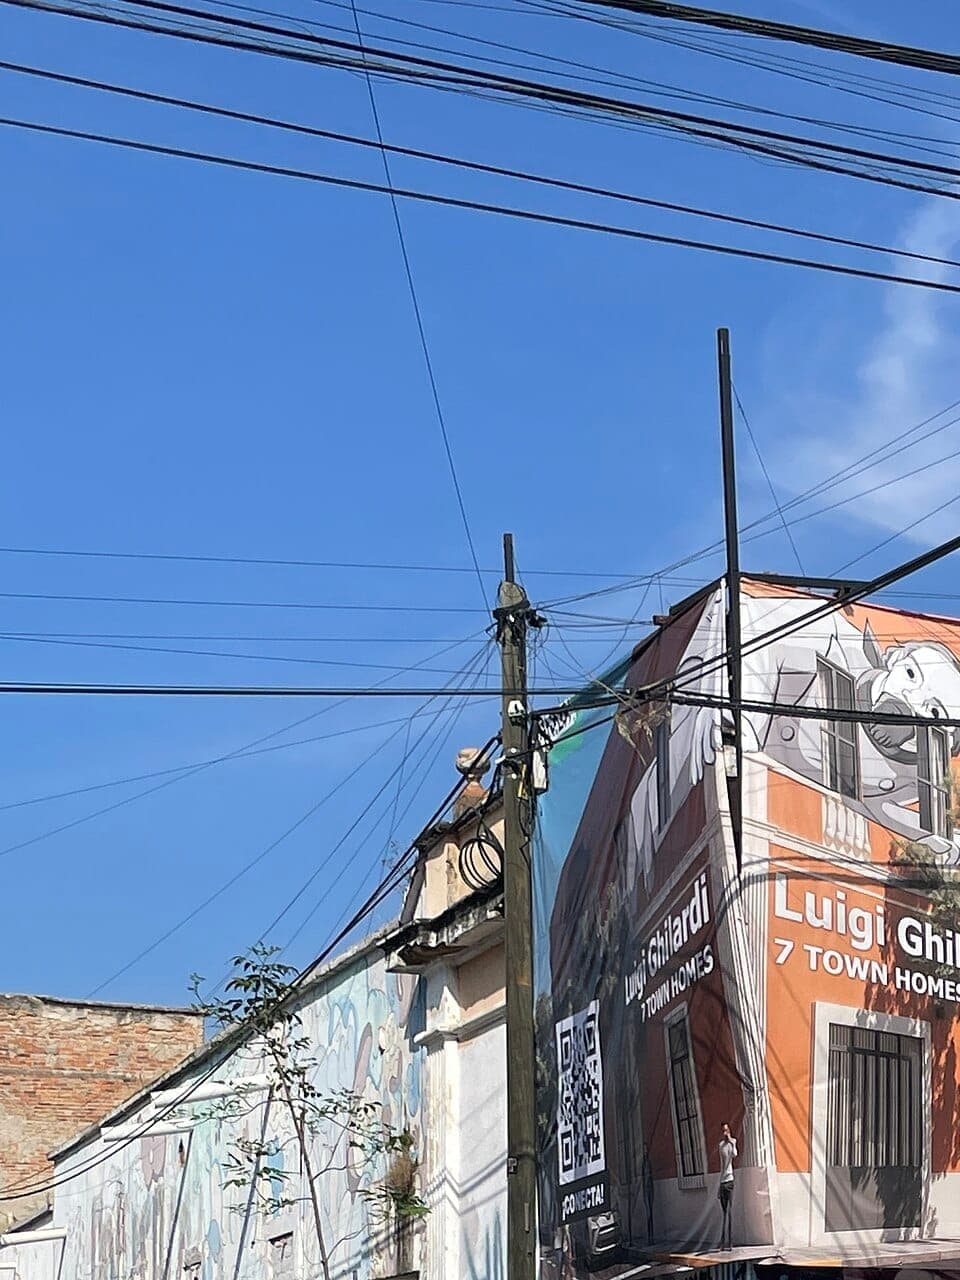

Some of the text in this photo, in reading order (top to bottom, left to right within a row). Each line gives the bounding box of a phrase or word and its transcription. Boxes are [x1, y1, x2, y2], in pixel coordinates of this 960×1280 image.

[624, 872, 710, 1006] Luigi Ghilardi
[773, 872, 885, 950] Luigi
[646, 980, 670, 1018] TOWN
[670, 944, 714, 999] HOMES
[773, 938, 795, 965] 7
[803, 944, 888, 986] TOWN
[561, 1183, 604, 1221] ¡CONECTA!
